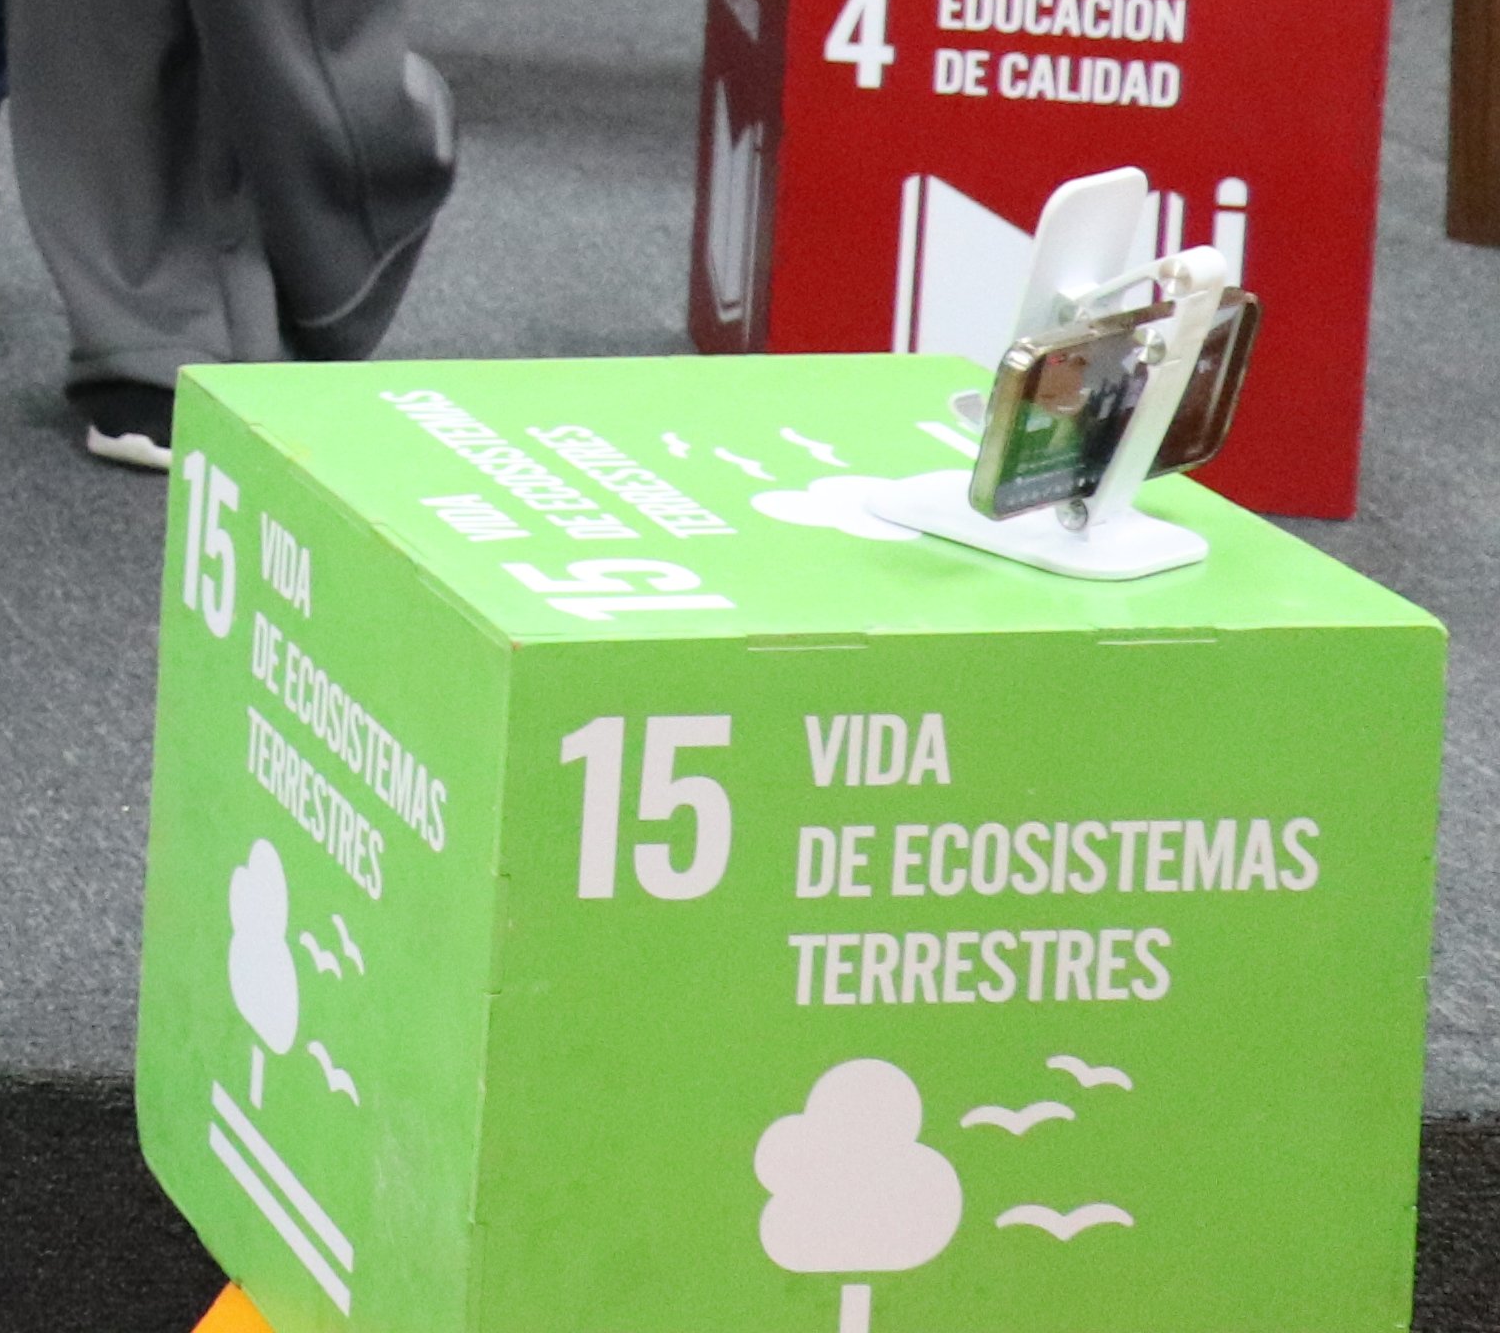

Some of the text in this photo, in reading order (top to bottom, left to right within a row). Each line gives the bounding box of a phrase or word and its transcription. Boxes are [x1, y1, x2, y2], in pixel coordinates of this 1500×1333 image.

[936, 49, 1179, 106] DE CALIDAD
[380, 390, 639, 539] DE ECOSISTEMAS
[421, 494, 527, 541] VIDA
[526, 425, 736, 538] TERRESTRES
[185, 452, 238, 636] 15
[257, 512, 309, 621] VIDA
[501, 558, 736, 621] 15
[251, 611, 445, 852] DE ECOSISTEMAS
[807, 714, 949, 785] VIDA
[247, 706, 383, 900] TERRESTRES
[562, 716, 730, 898] 15
[796, 819, 1317, 897] DE ECOSISTEMAS
[790, 929, 1168, 1003] TERRESTRES
